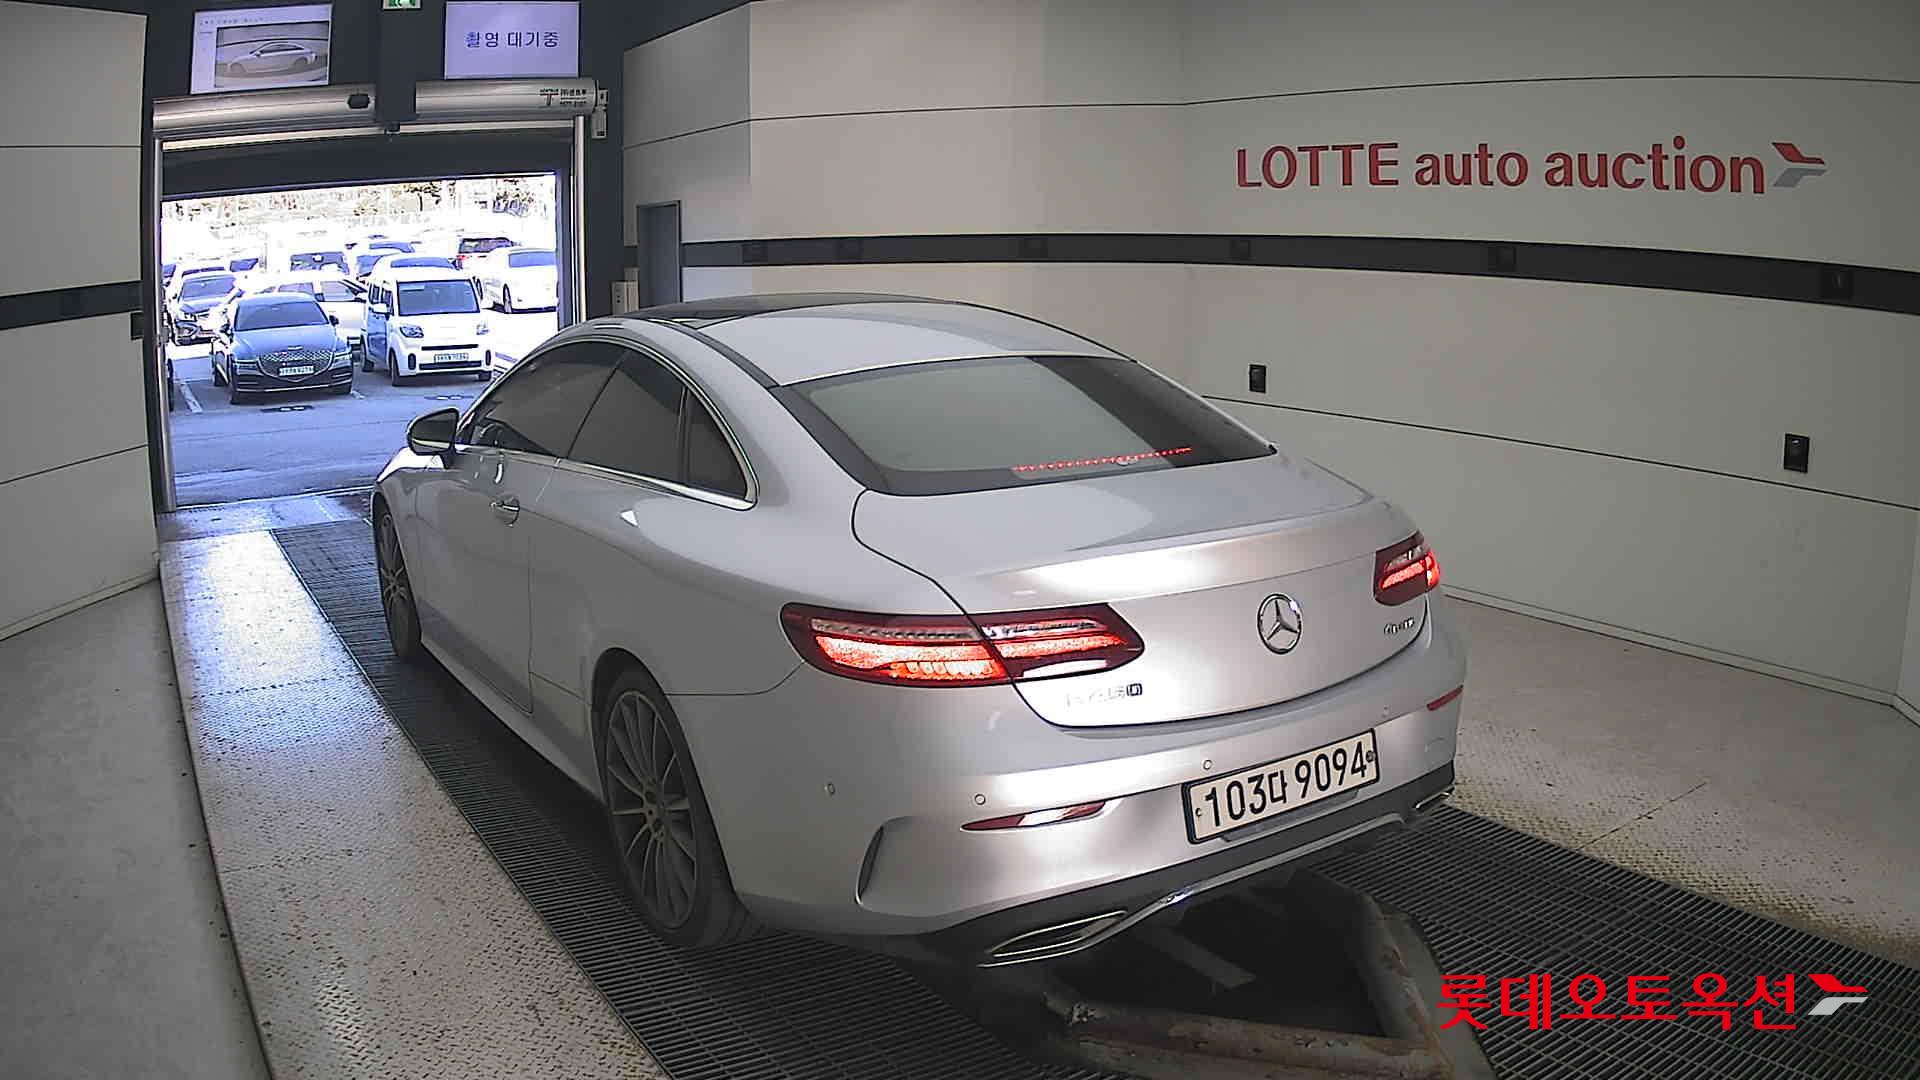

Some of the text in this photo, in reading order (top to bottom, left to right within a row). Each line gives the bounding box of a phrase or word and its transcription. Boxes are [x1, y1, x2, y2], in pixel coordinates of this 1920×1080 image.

[507, 31, 560, 48] 대기중
[1237, 136, 1765, 194] LOTTE auto auction
[1205, 741, 1367, 827] 103다 9094
